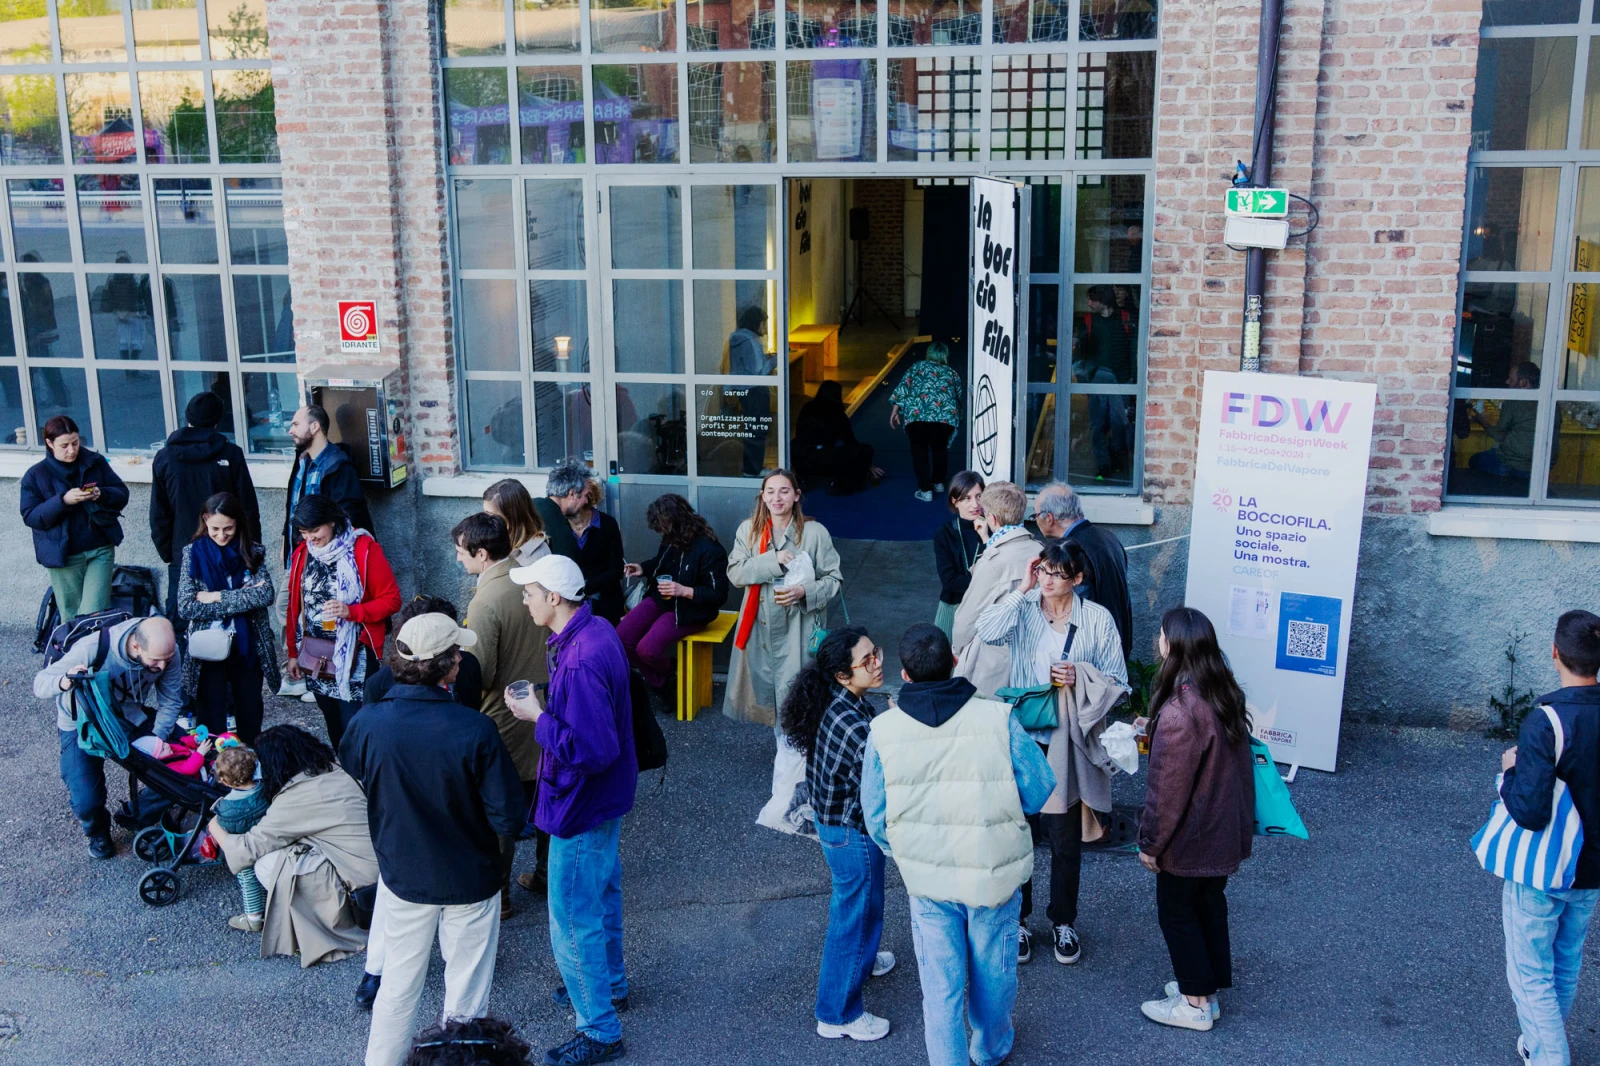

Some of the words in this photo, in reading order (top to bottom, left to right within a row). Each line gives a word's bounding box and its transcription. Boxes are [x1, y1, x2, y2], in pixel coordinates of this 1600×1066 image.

[982, 233, 1013, 278] boc
[976, 271, 997, 314] cio
[342, 341, 378, 349] IDRANTE
[982, 319, 1012, 367] fila
[700, 389, 714, 397] c/o
[724, 389, 749, 397] careof
[700, 414, 757, 423] Organizzazione
[1220, 391, 1352, 434] FDW
[700, 422, 725, 430] profit
[744, 422, 769, 430] l'arte
[701, 430, 756, 438] contemporanea.
[1219, 429, 1348, 450] FabbricaDesignWeek
[1216, 456, 1331, 476] FabbricaDelVapore
[1212, 493, 1233, 507] 20
[1239, 496, 1257, 508] LA
[1237, 509, 1332, 531] BOCCIOFILA.
[1236, 525, 1262, 538] Uno
[1265, 531, 1307, 543] spazio
[1235, 539, 1283, 553] sociale.
[1234, 549, 1258, 562] Una
[1262, 555, 1310, 568] mostra.
[1232, 565, 1280, 580] CAREOF
[1260, 728, 1293, 740] FABBRICA
[1270, 736, 1292, 744] VAPORE
